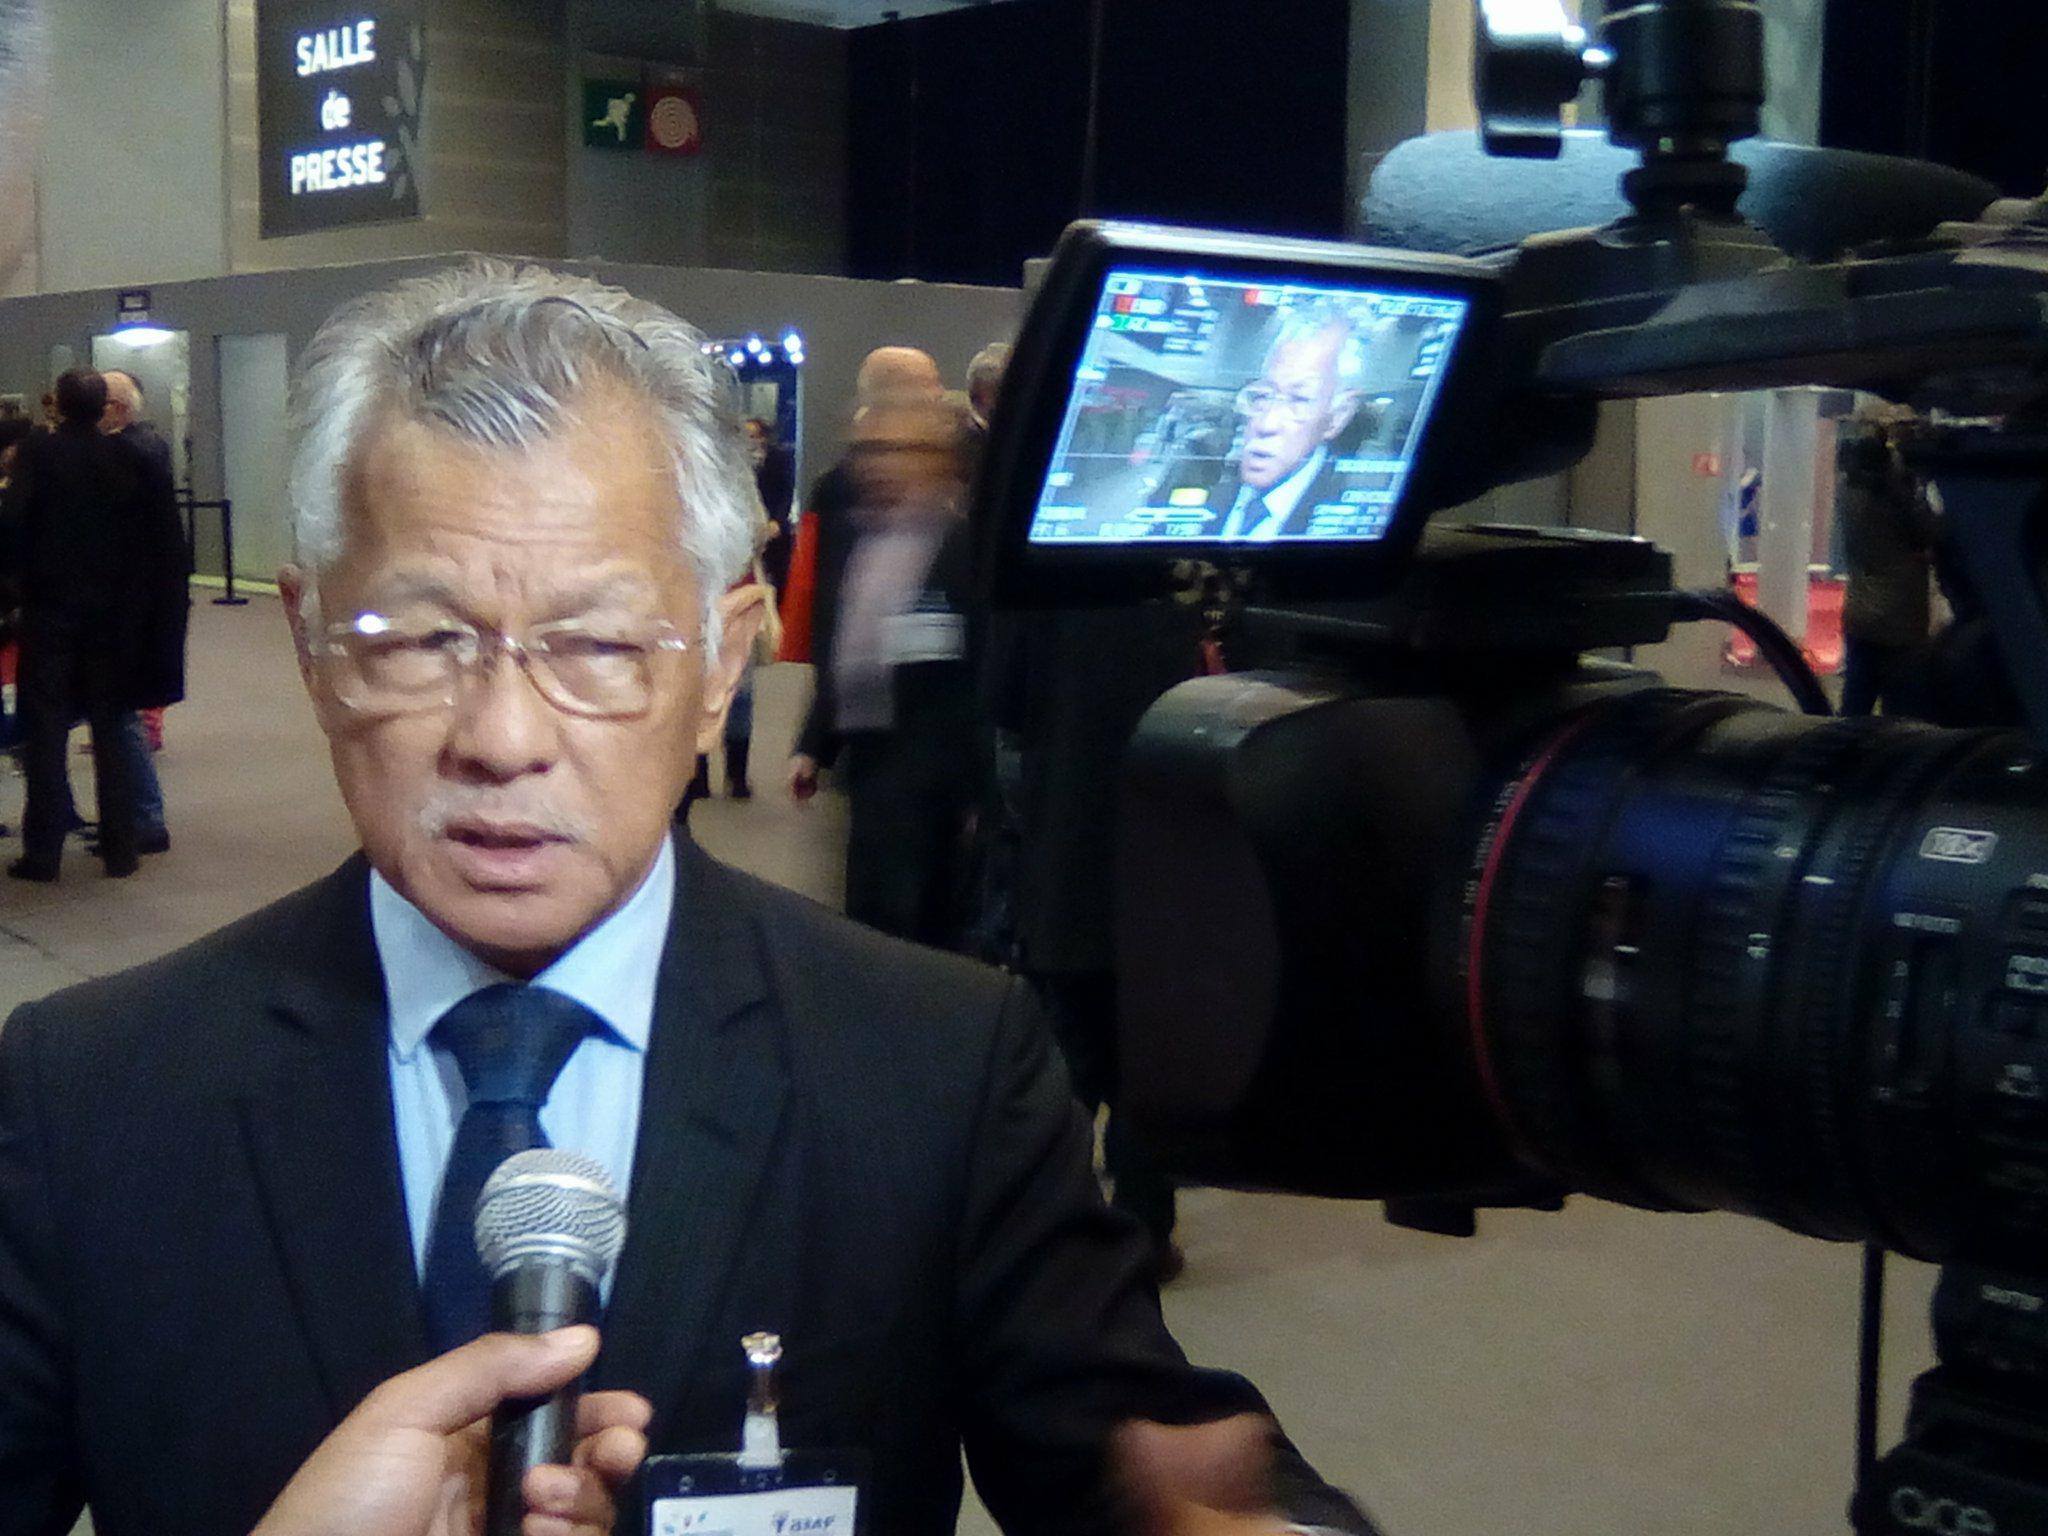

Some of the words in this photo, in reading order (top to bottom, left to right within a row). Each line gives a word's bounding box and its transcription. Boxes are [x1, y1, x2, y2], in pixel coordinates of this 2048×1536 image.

[296, 20, 376, 76] SALLE
[321, 88, 351, 130] de
[291, 142, 387, 195] PRESSE
